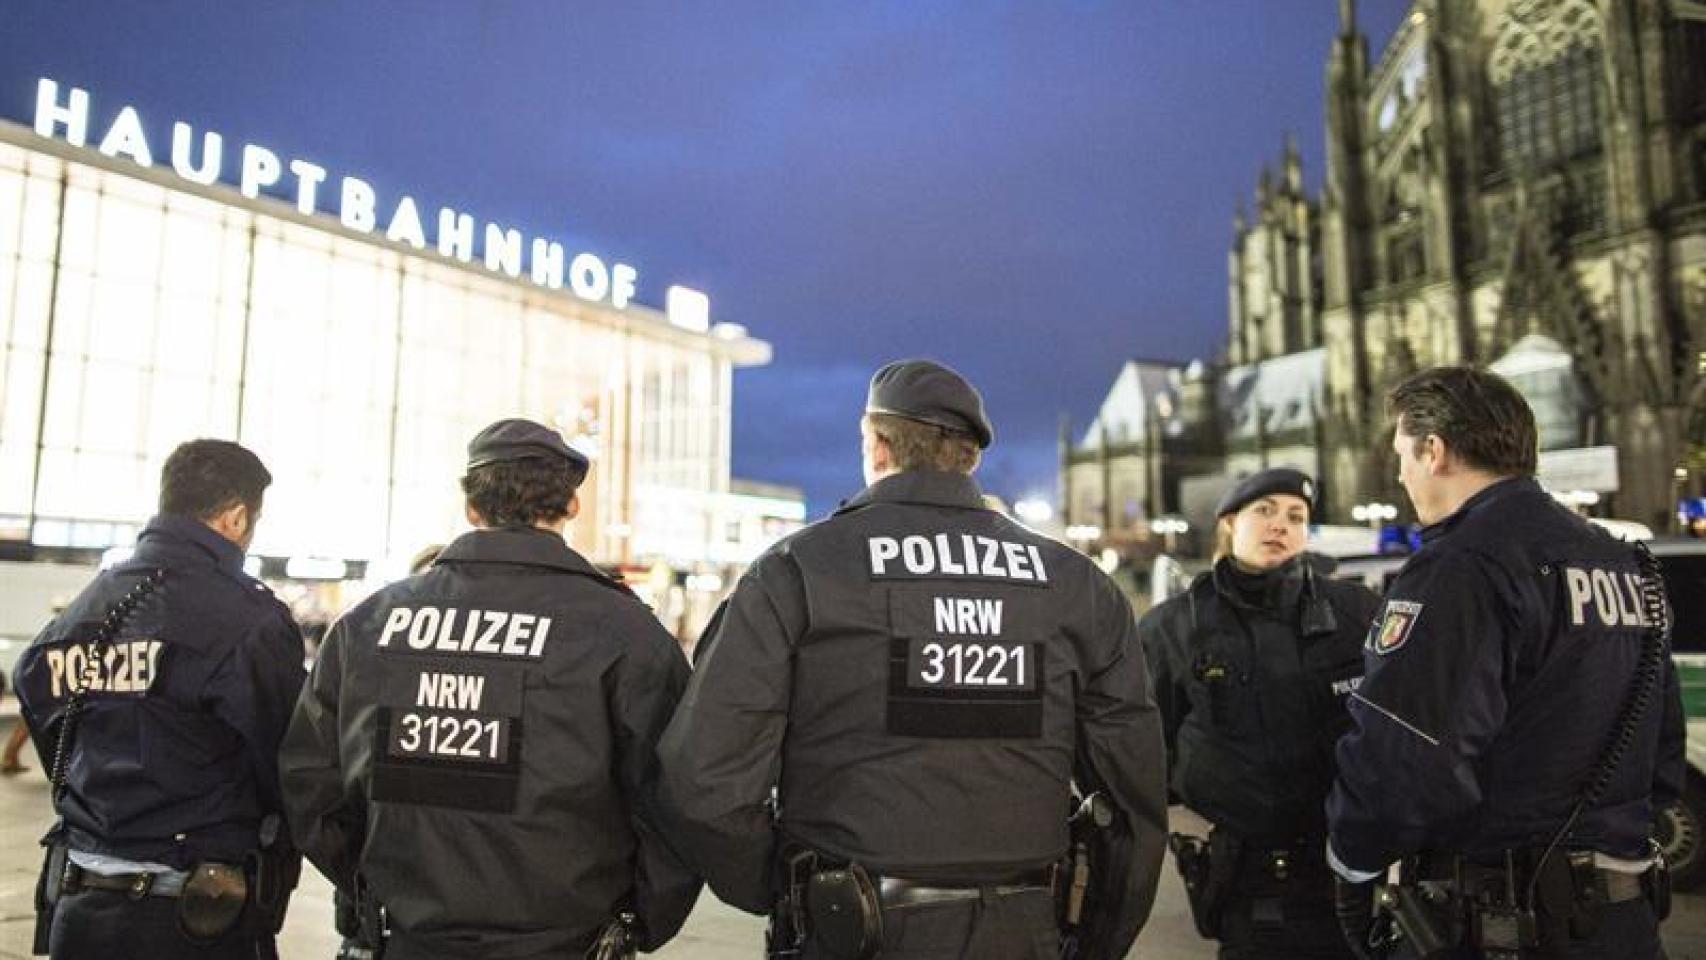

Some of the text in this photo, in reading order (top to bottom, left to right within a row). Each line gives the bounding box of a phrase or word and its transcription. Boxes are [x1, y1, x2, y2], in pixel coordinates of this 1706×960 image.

[34, 78, 637, 308] HAUPTBAHNHOF
[868, 533, 1047, 582] POLIZEI
[933, 597, 1003, 635] NRW
[1566, 567, 1661, 627] POLI
[377, 606, 552, 657] POLIZEI
[920, 643, 1025, 686] 31221
[416, 671, 484, 711] NRW
[400, 713, 500, 758] 31221
